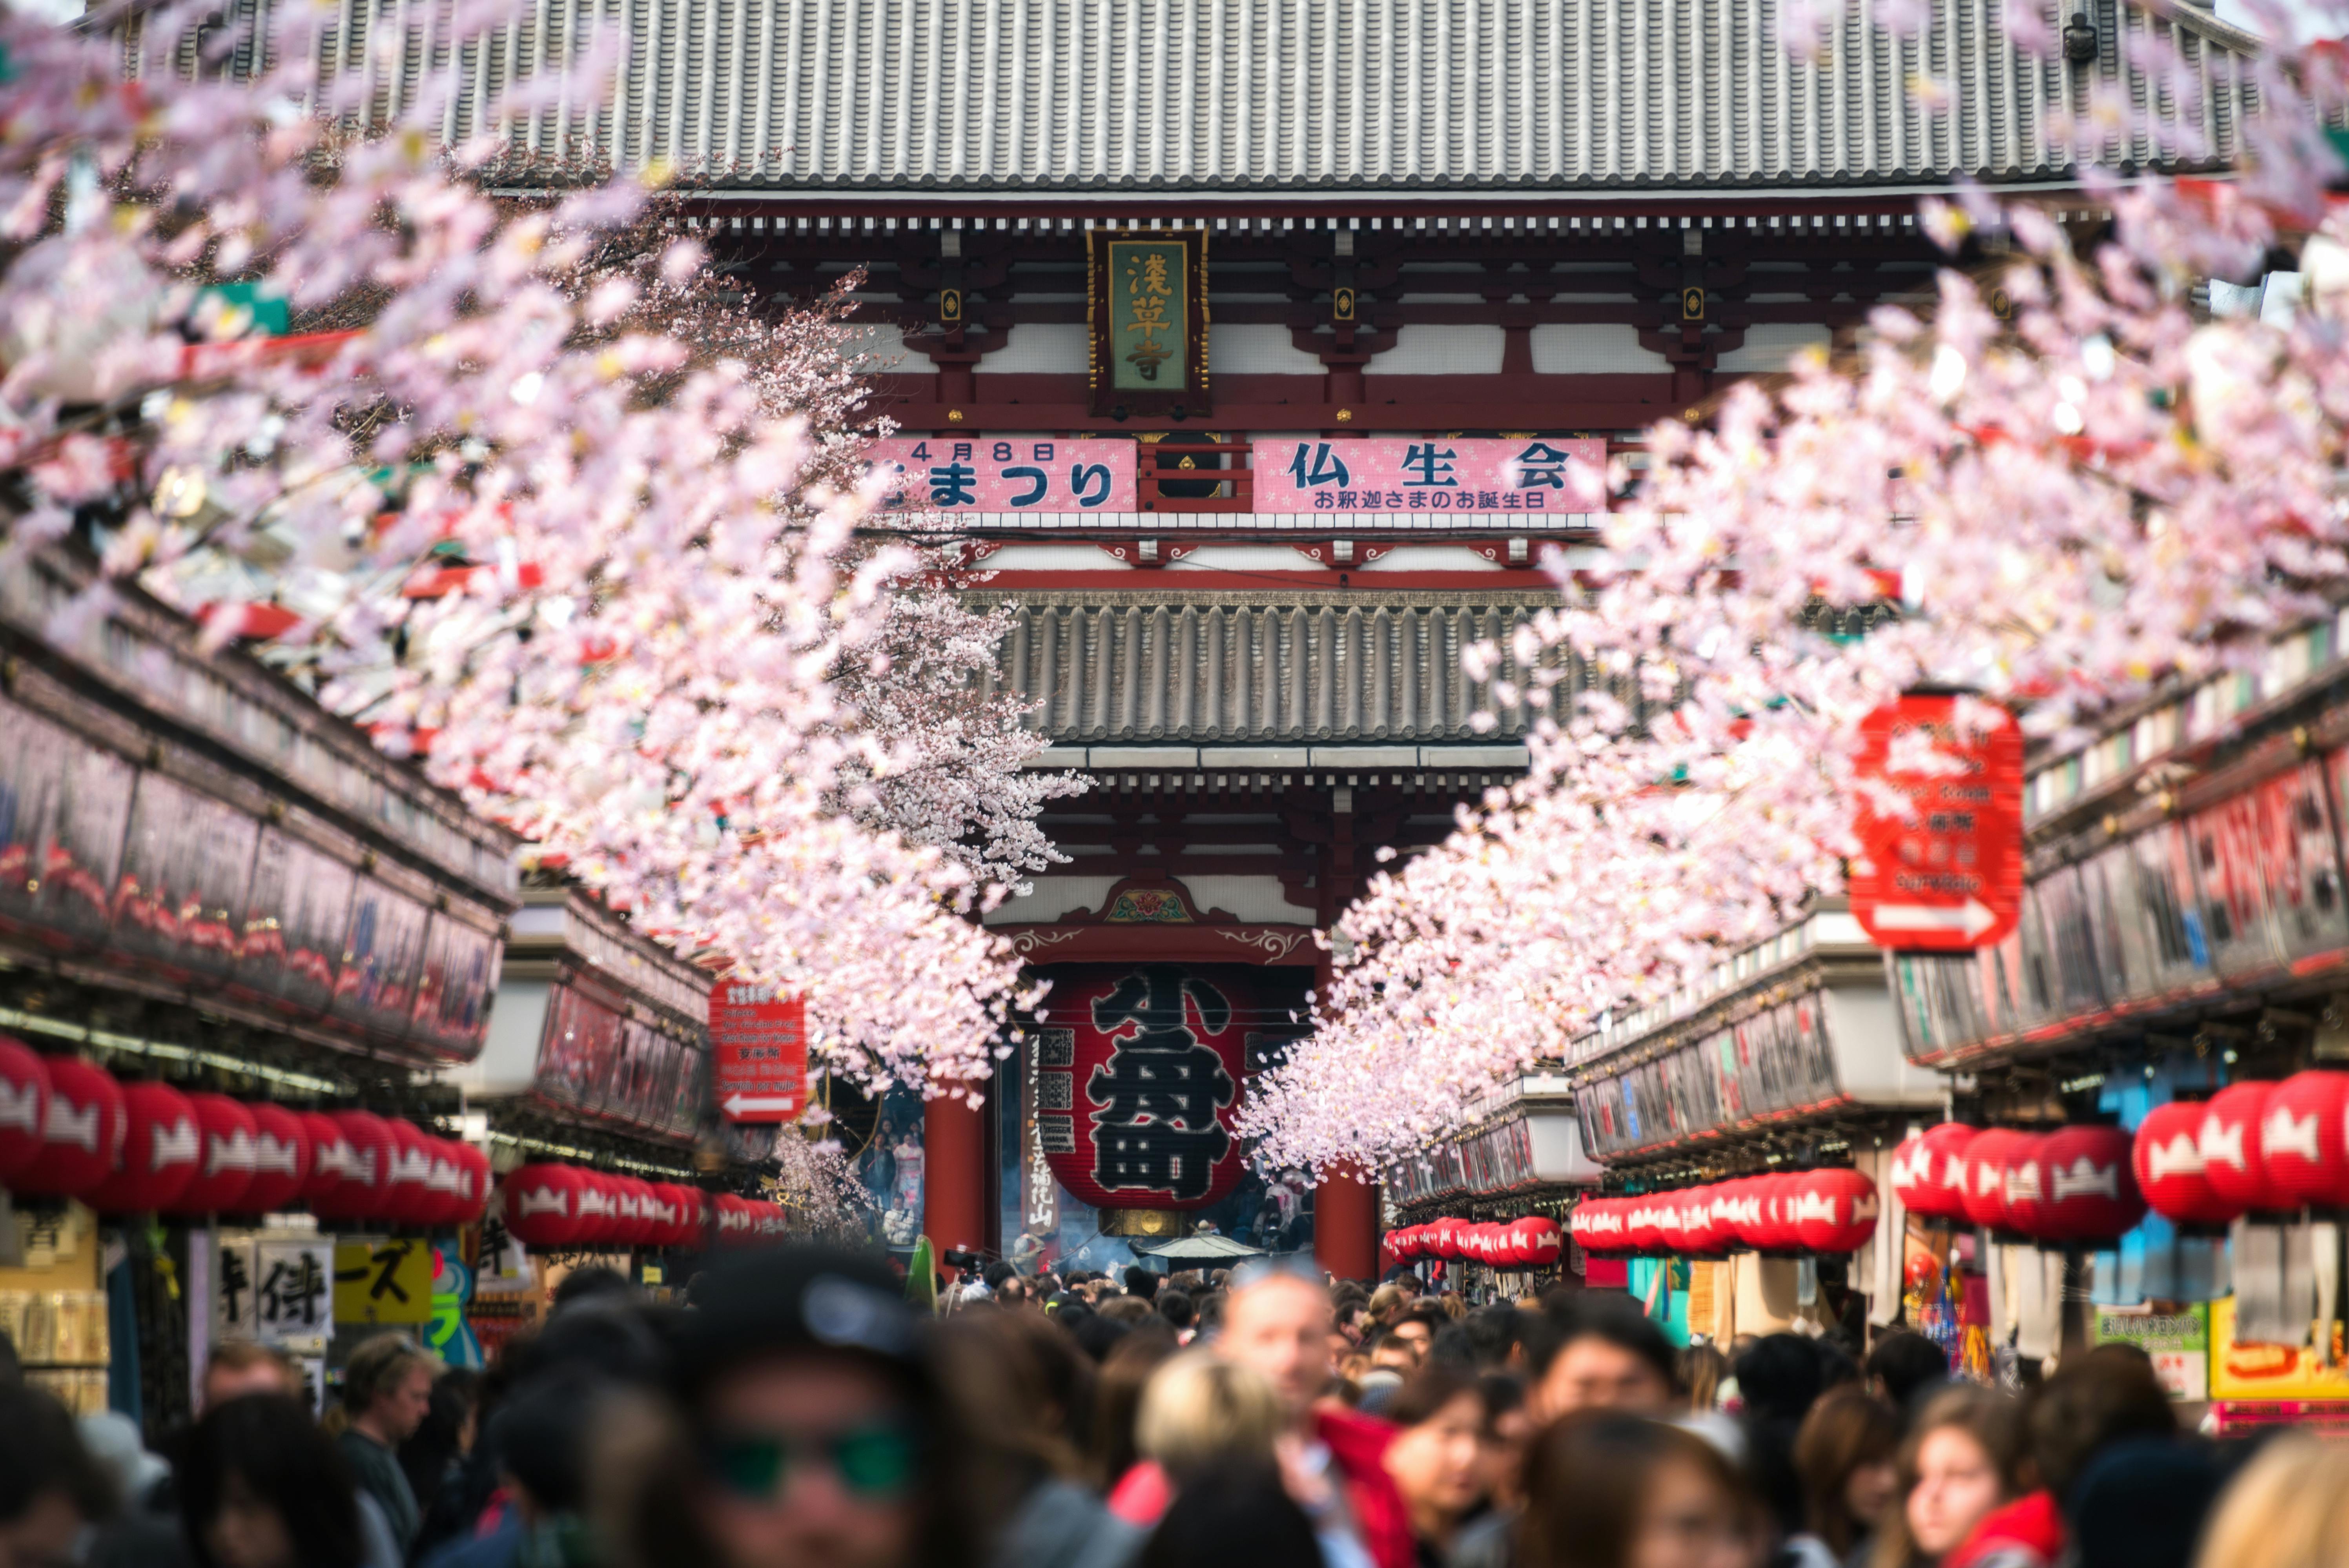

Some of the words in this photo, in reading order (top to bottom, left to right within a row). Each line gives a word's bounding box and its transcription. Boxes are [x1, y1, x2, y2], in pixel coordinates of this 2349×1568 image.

[911, 441, 1054, 462] 4月8日
[1288, 442, 1571, 489] 仏生会
[1314, 490, 1544, 509] お釈迦さまのお誕生日
